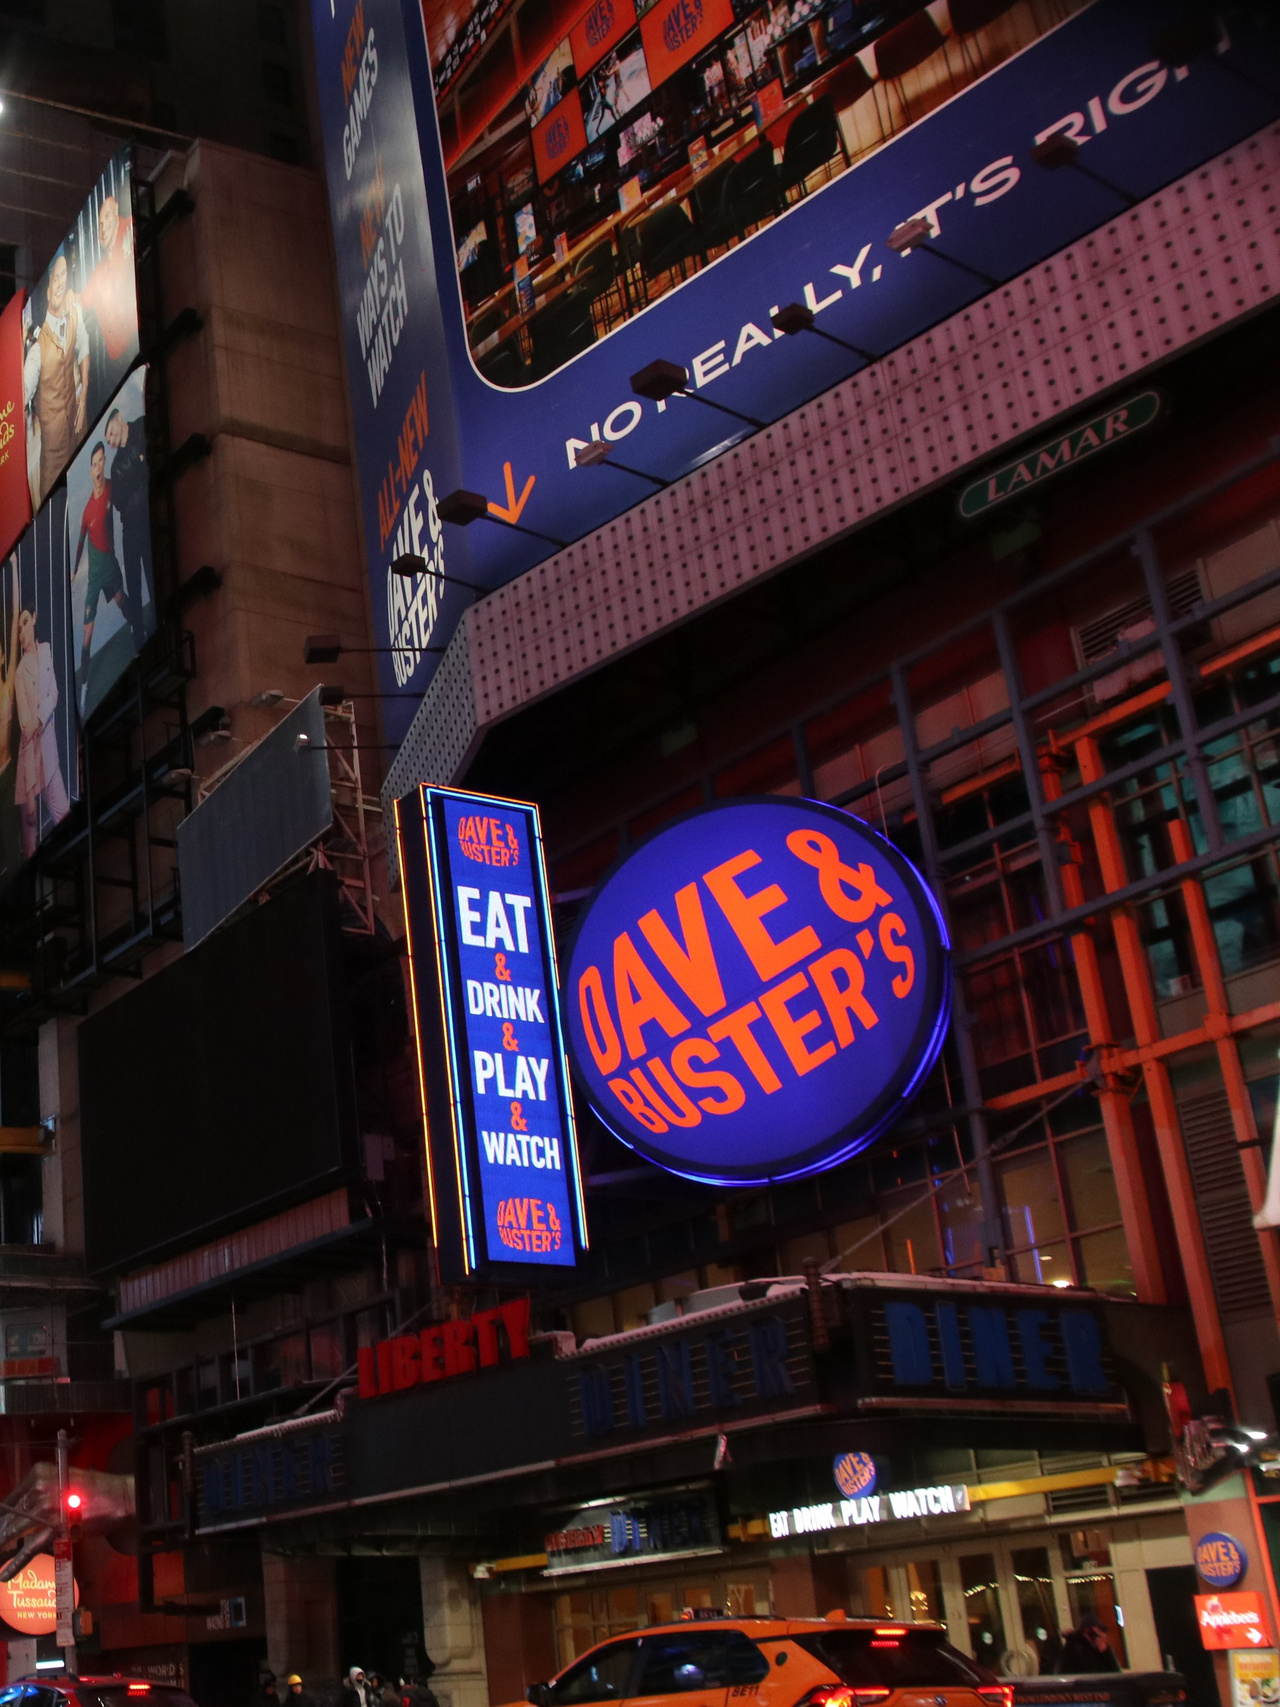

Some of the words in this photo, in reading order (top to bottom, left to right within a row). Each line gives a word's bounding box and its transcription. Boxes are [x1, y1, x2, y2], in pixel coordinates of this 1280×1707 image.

[343, 27, 378, 181] GAMES
[356, 236, 388, 362] WAYS
[384, 182, 405, 265] TO
[367, 257, 409, 410] WATCH
[566, 401, 642, 470] NO
[656, 242, 883, 414] EALY,
[377, 369, 429, 553] ALL-NEW
[987, 408, 1129, 502] LAMAR
[387, 483, 425, 647] DAVE
[423, 468, 443, 543] &
[391, 534, 445, 689] BUSTER'S
[458, 816, 506, 849] DAVE
[505, 823, 519, 851] &
[460, 840, 520, 868] BUSTER'S
[457, 885, 532, 954] EAT
[494, 952, 512, 982] &
[578, 848, 822, 1076] DAVE
[785, 829, 894, 923] &
[466, 979, 545, 1024] DRINK
[607, 912, 916, 1134] BUSTER'S
[502, 1021, 520, 1052] &
[473, 1050, 549, 1101] PLAY
[510, 1100, 528, 1132] &
[481, 1130, 561, 1170] WATCH
[496, 1197, 547, 1231] DAVE
[546, 1202, 562, 1231] &
[497, 1227, 563, 1253] BUSTER'S
[356, 1297, 531, 1399] LIBERTY
[578, 1314, 797, 1436] DINER
[884, 1300, 1111, 1395] DINER
[769, 1510, 790, 1539] EAT
[792, 1502, 837, 1535] DRINK
[840, 1495, 881, 1527] PLAY
[888, 1484, 957, 1520] WATCH
[7, 1569, 56, 1591] Madam
[1197, 1541, 1230, 1564] DAVE
[17, 1611, 35, 1619] NEW
